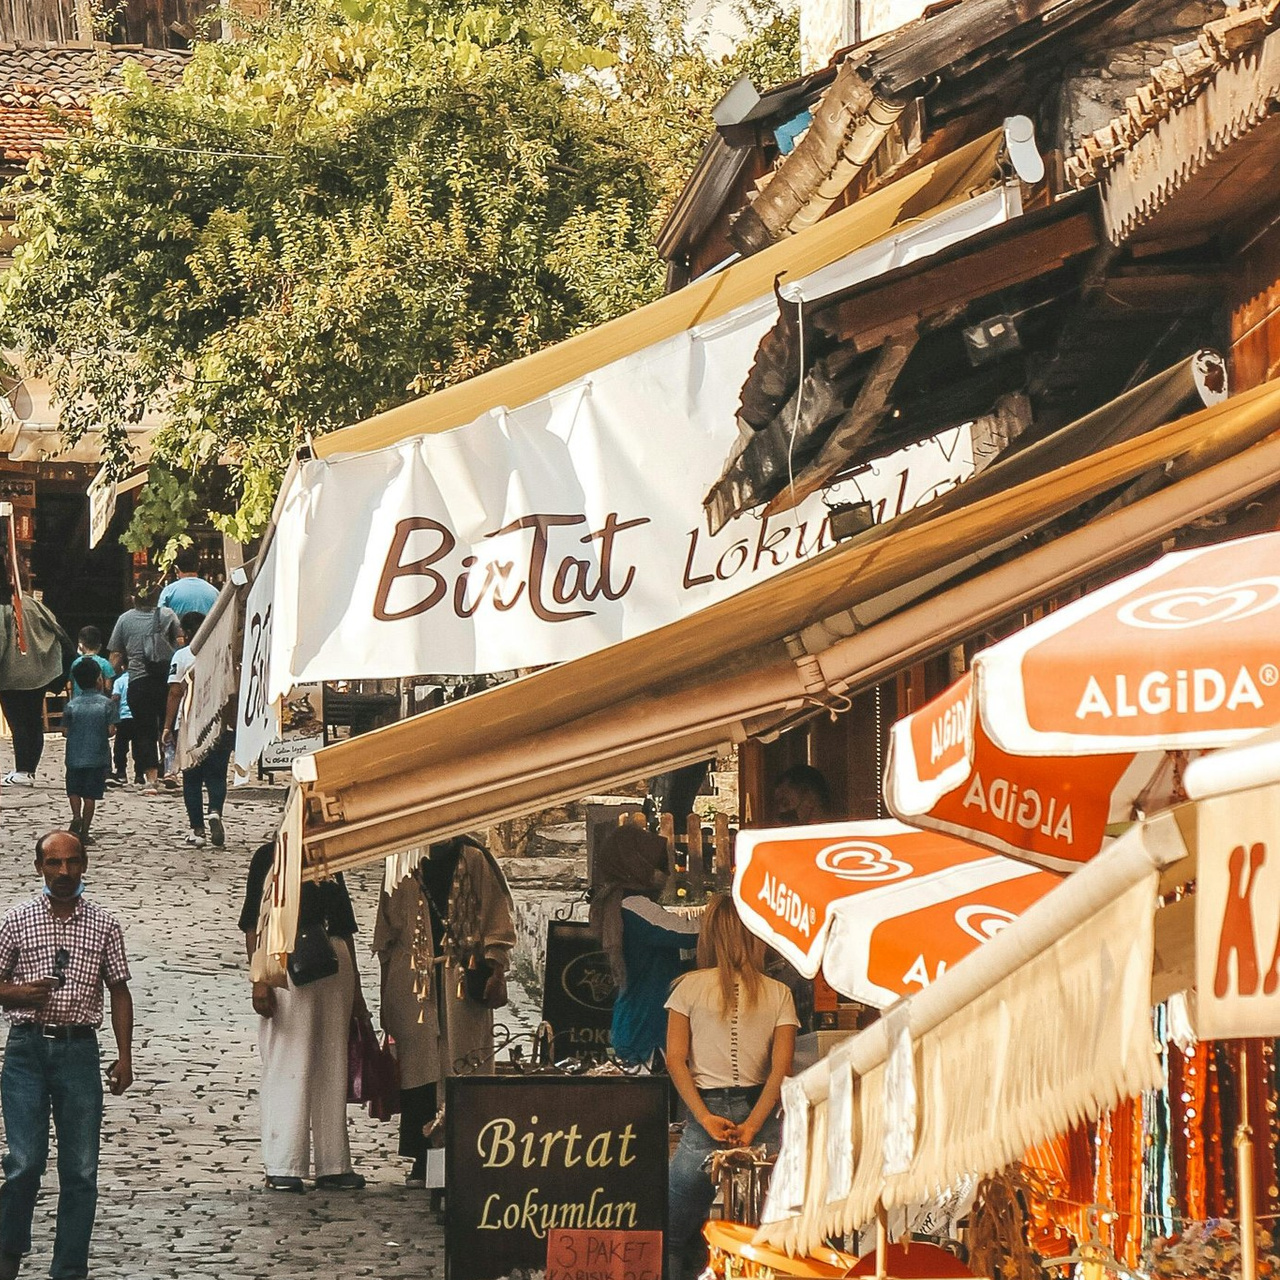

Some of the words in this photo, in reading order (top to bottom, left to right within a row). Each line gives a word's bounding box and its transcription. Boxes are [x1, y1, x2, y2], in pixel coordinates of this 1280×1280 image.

[477, 1115, 637, 1168] Birtat
[477, 1187, 638, 1239] Lokumları
[556, 1235, 577, 1267] 3
[586, 1236, 651, 1267] PAKET
